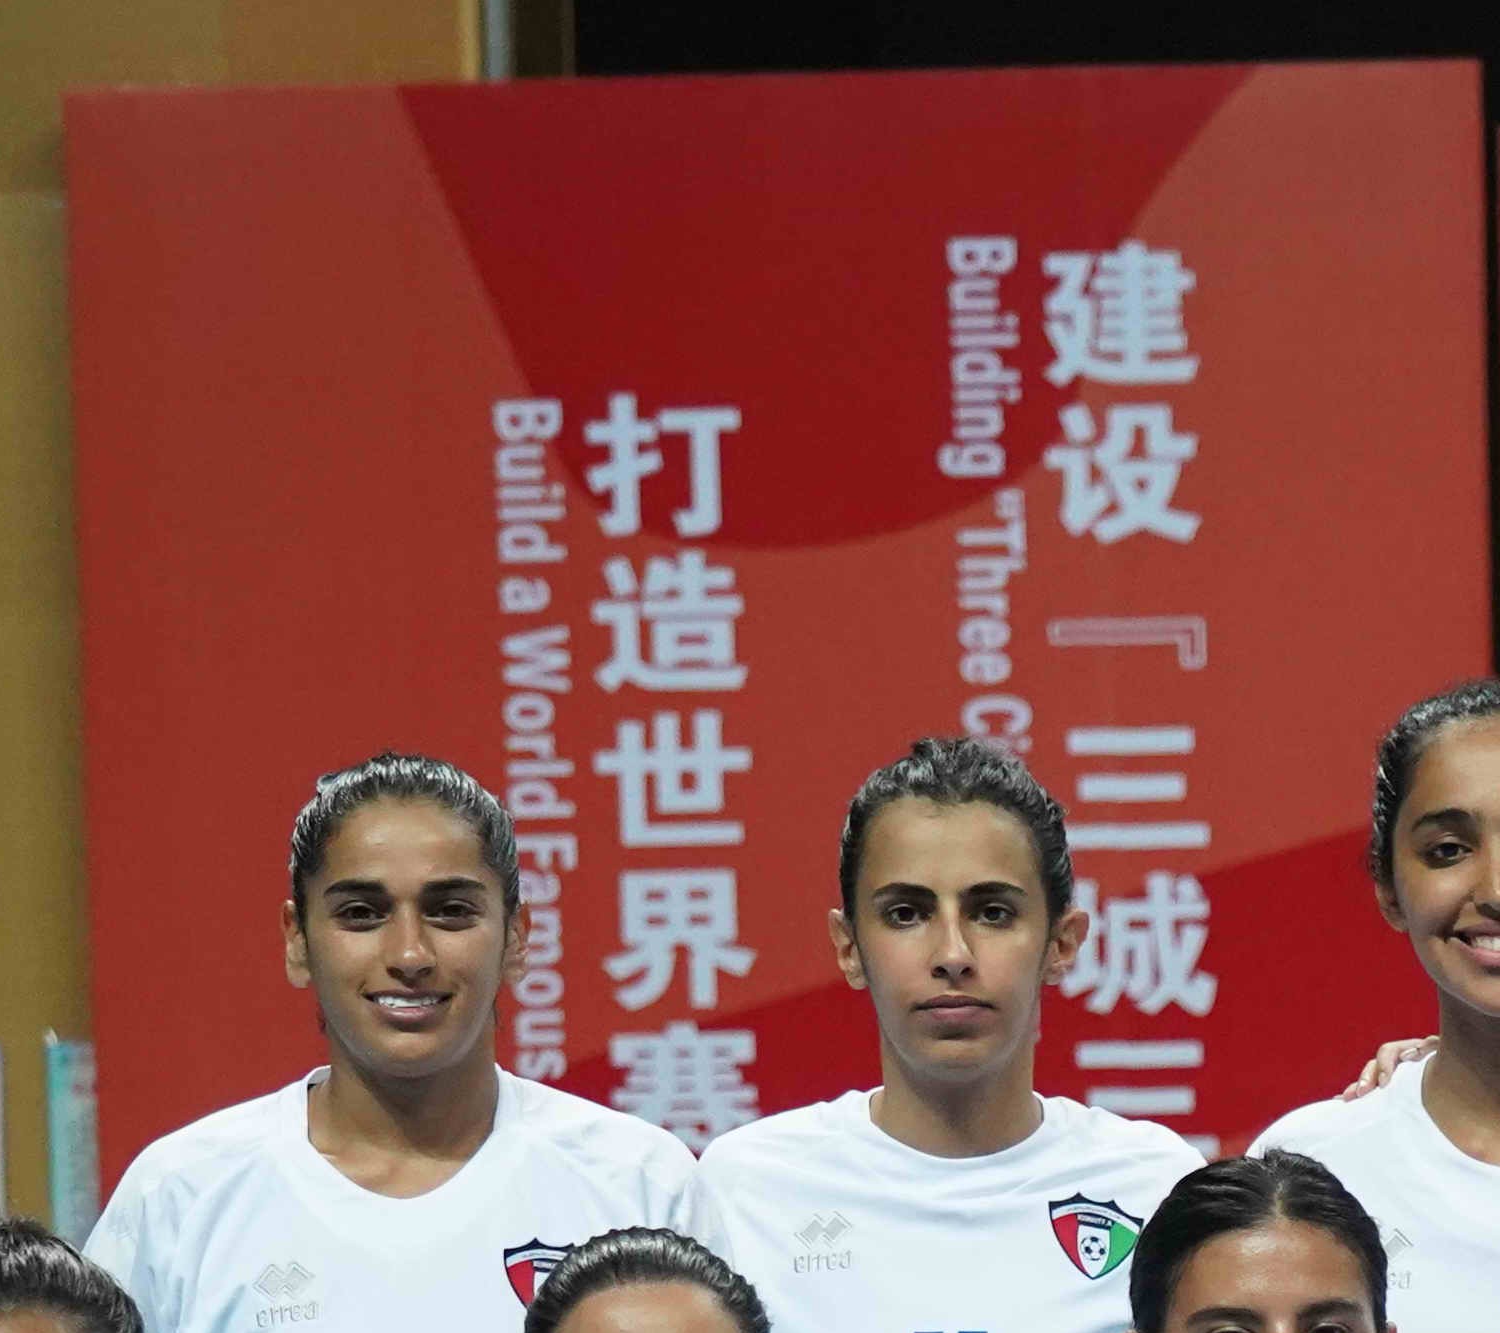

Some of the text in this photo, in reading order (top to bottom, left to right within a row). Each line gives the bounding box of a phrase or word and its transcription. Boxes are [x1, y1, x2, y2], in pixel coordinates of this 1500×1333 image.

[938, 235, 1021, 478] Building
[492, 398, 579, 1080] Build a World Famous
